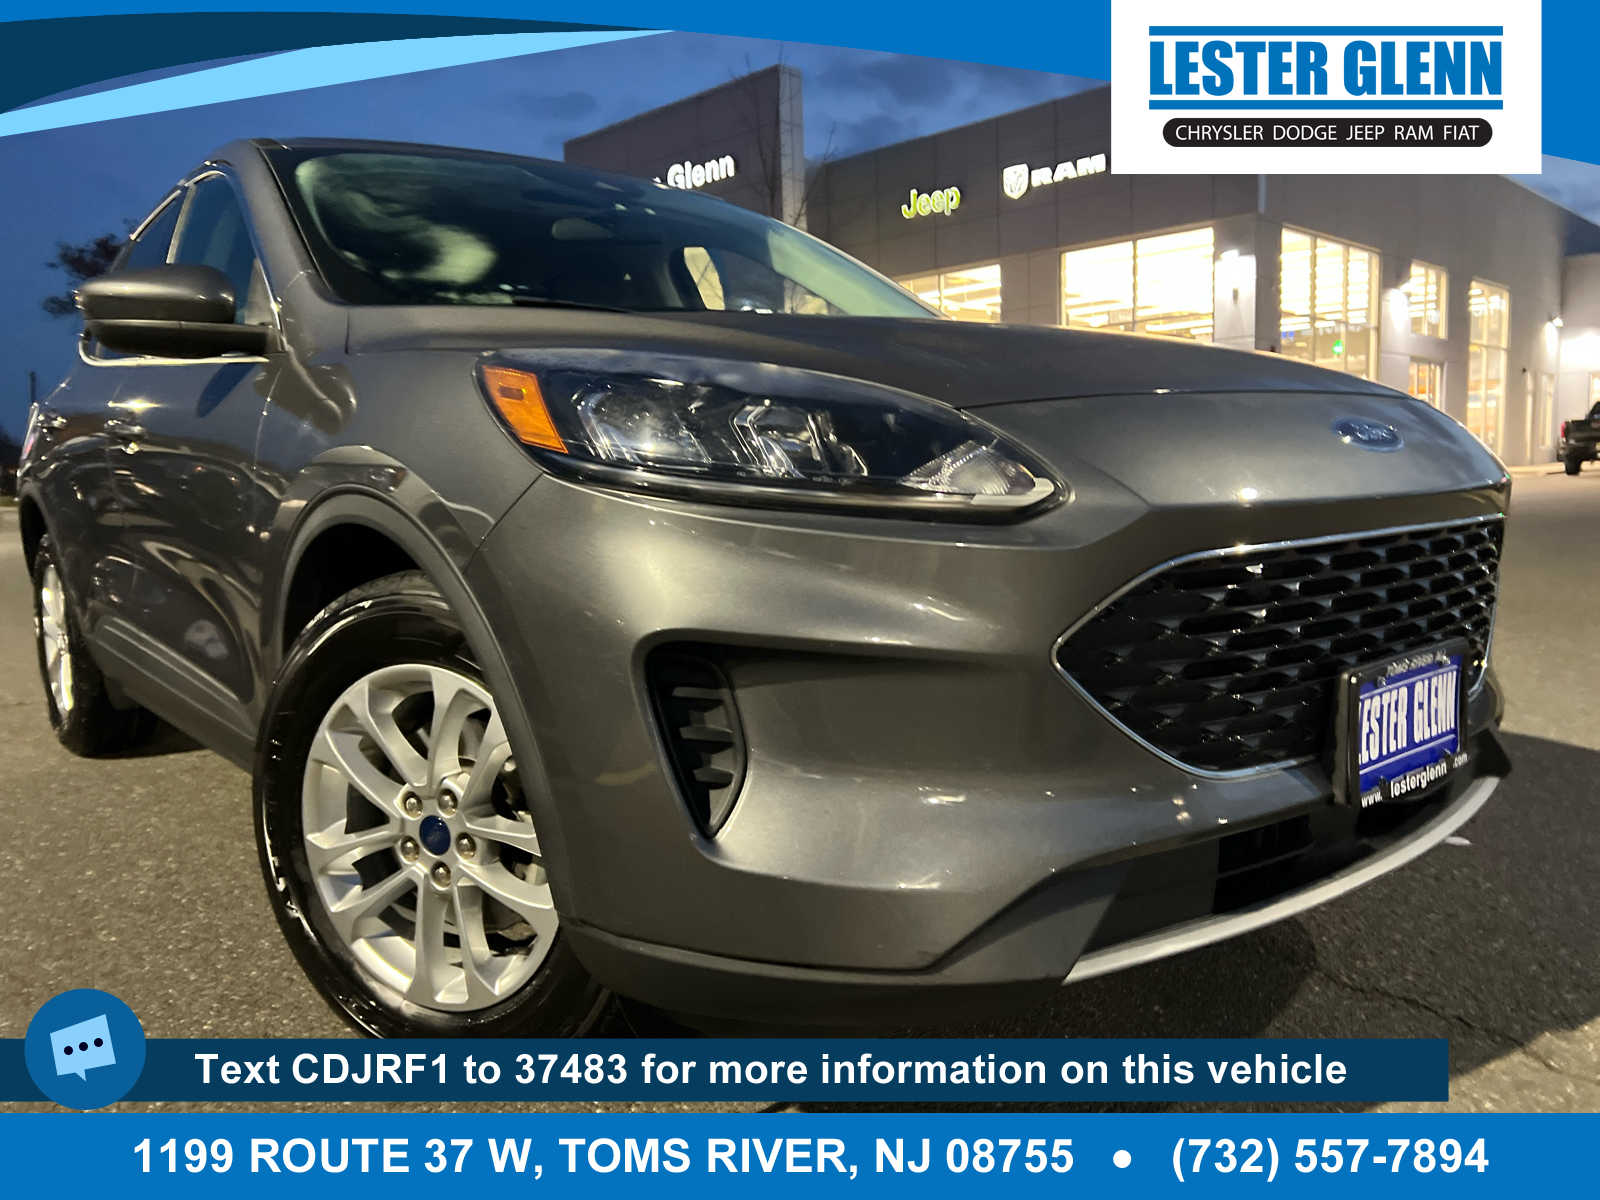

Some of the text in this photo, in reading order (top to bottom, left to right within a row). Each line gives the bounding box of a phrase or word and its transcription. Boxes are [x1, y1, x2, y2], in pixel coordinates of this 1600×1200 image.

[667, 155, 735, 190] Glenn
[1030, 153, 1107, 188] RAM
[901, 186, 961, 219] Jeep
[1413, 670, 1457, 743] GLENN
